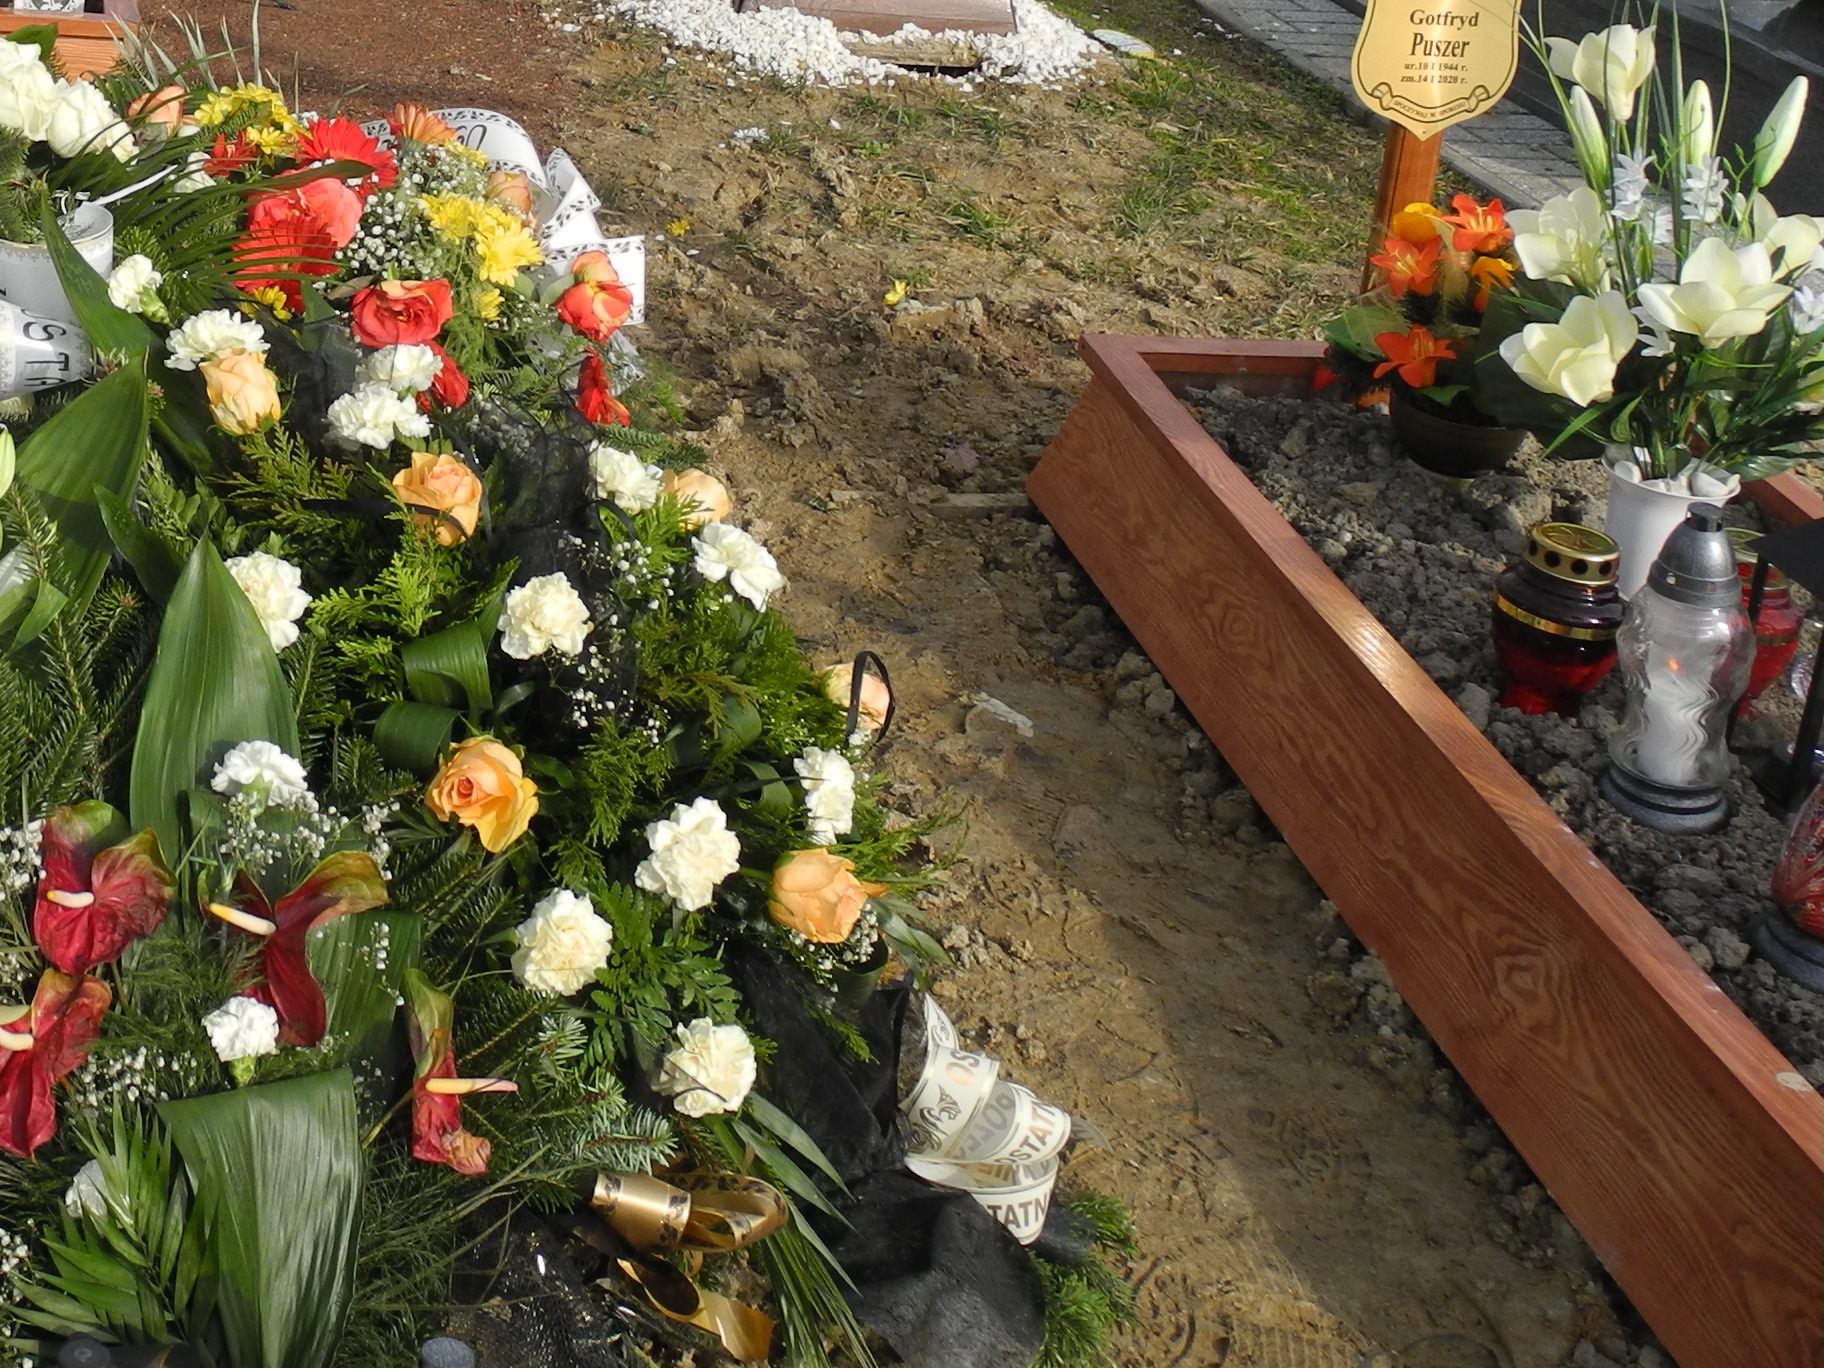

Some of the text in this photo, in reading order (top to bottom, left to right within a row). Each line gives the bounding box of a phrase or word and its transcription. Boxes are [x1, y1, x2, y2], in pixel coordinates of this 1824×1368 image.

[1409, 9, 1480, 31] Gotfryd
[1409, 32, 1470, 58] Puszer
[1438, 63, 1459, 72] 1944
[1437, 75, 1459, 84] 2020
